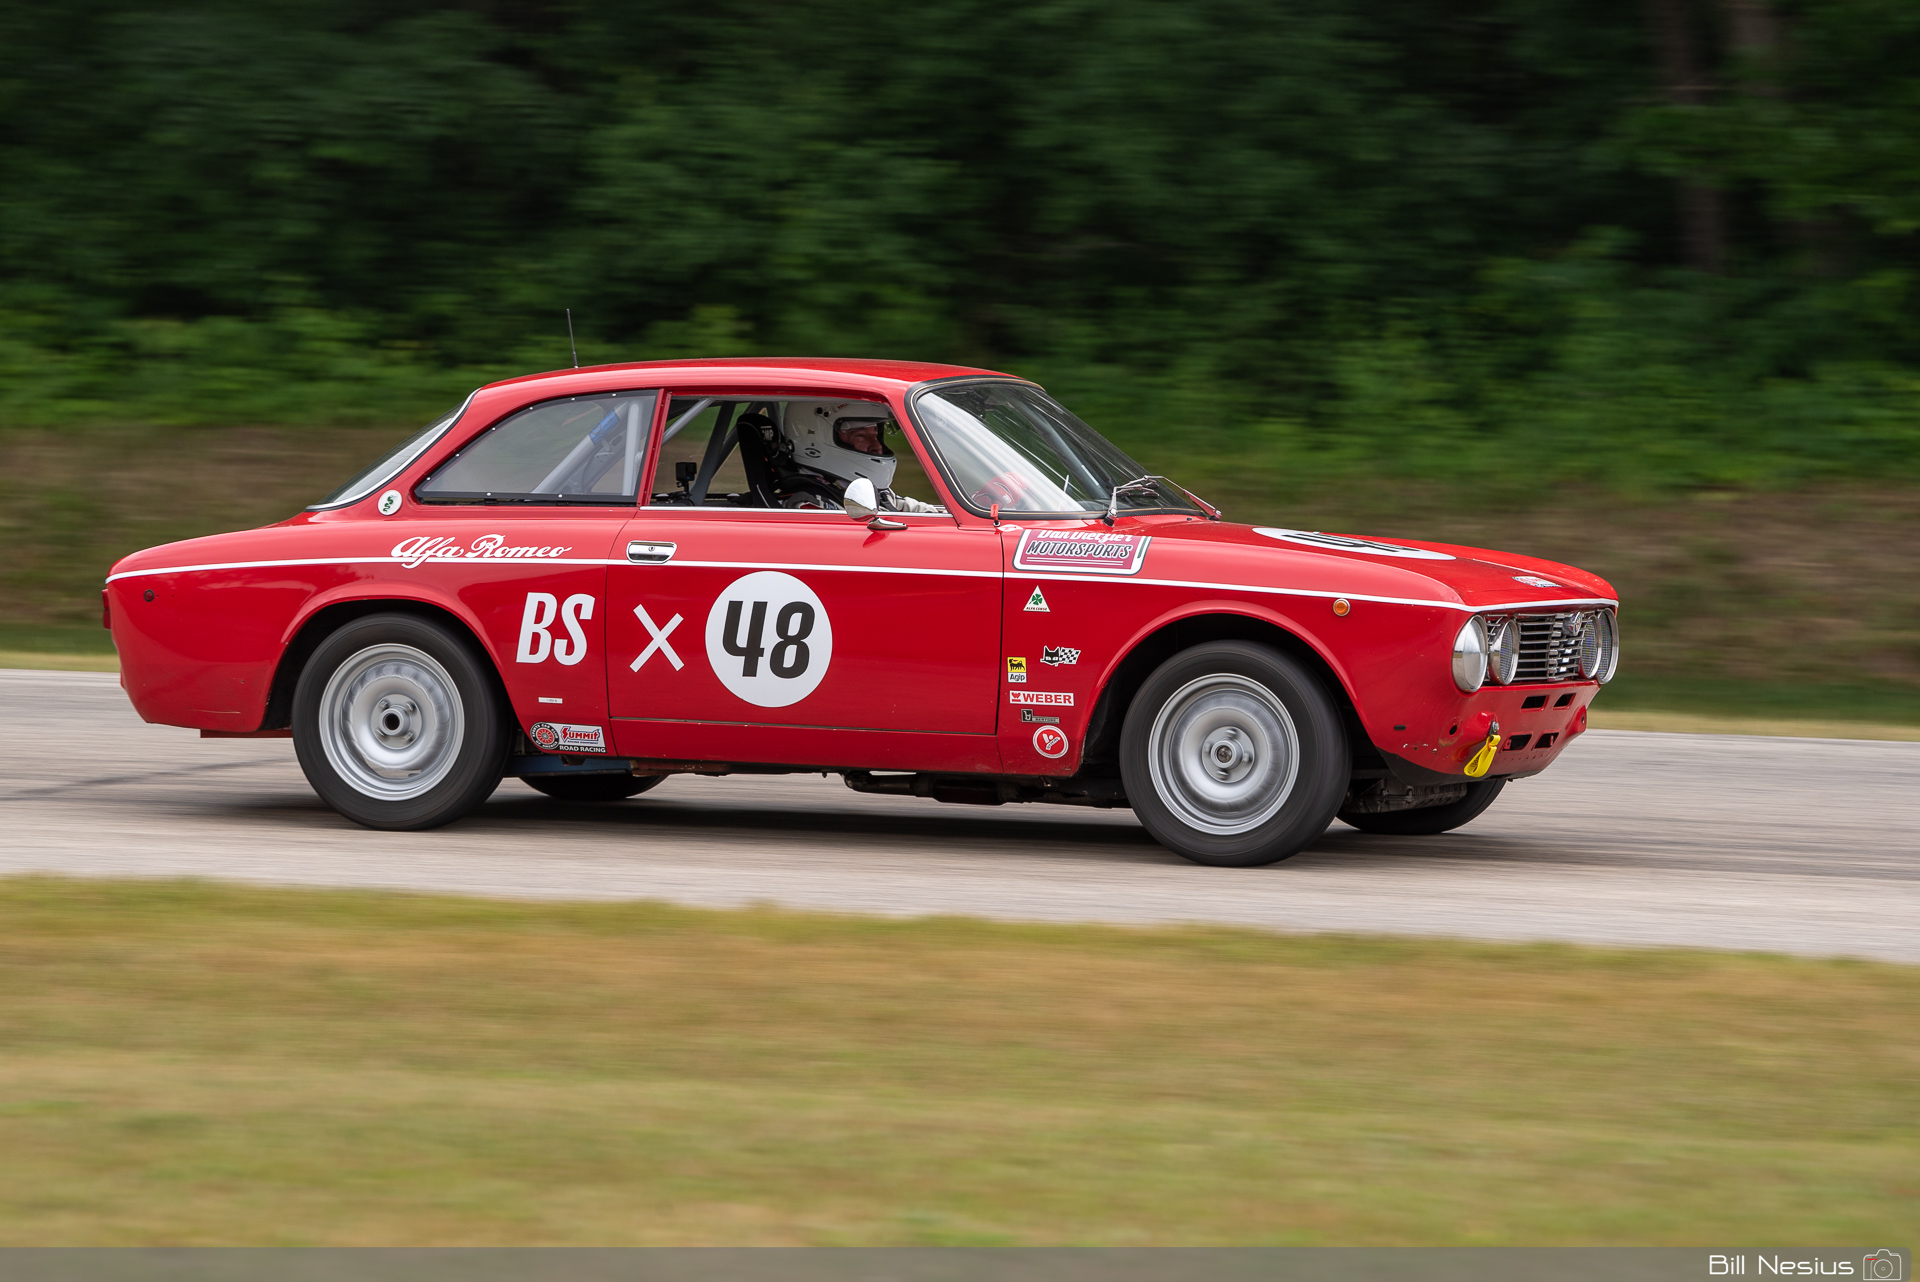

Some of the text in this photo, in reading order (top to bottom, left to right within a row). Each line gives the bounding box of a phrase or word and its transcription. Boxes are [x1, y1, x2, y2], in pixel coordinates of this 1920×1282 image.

[390, 533, 573, 569] Alfa Romeo
[1026, 540, 1133, 559] MOTORSPORTS
[516, 591, 596, 666] BS
[722, 600, 816, 679] 48
[1009, 673, 1026, 682] Agip
[1022, 692, 1073, 704] WEBER
